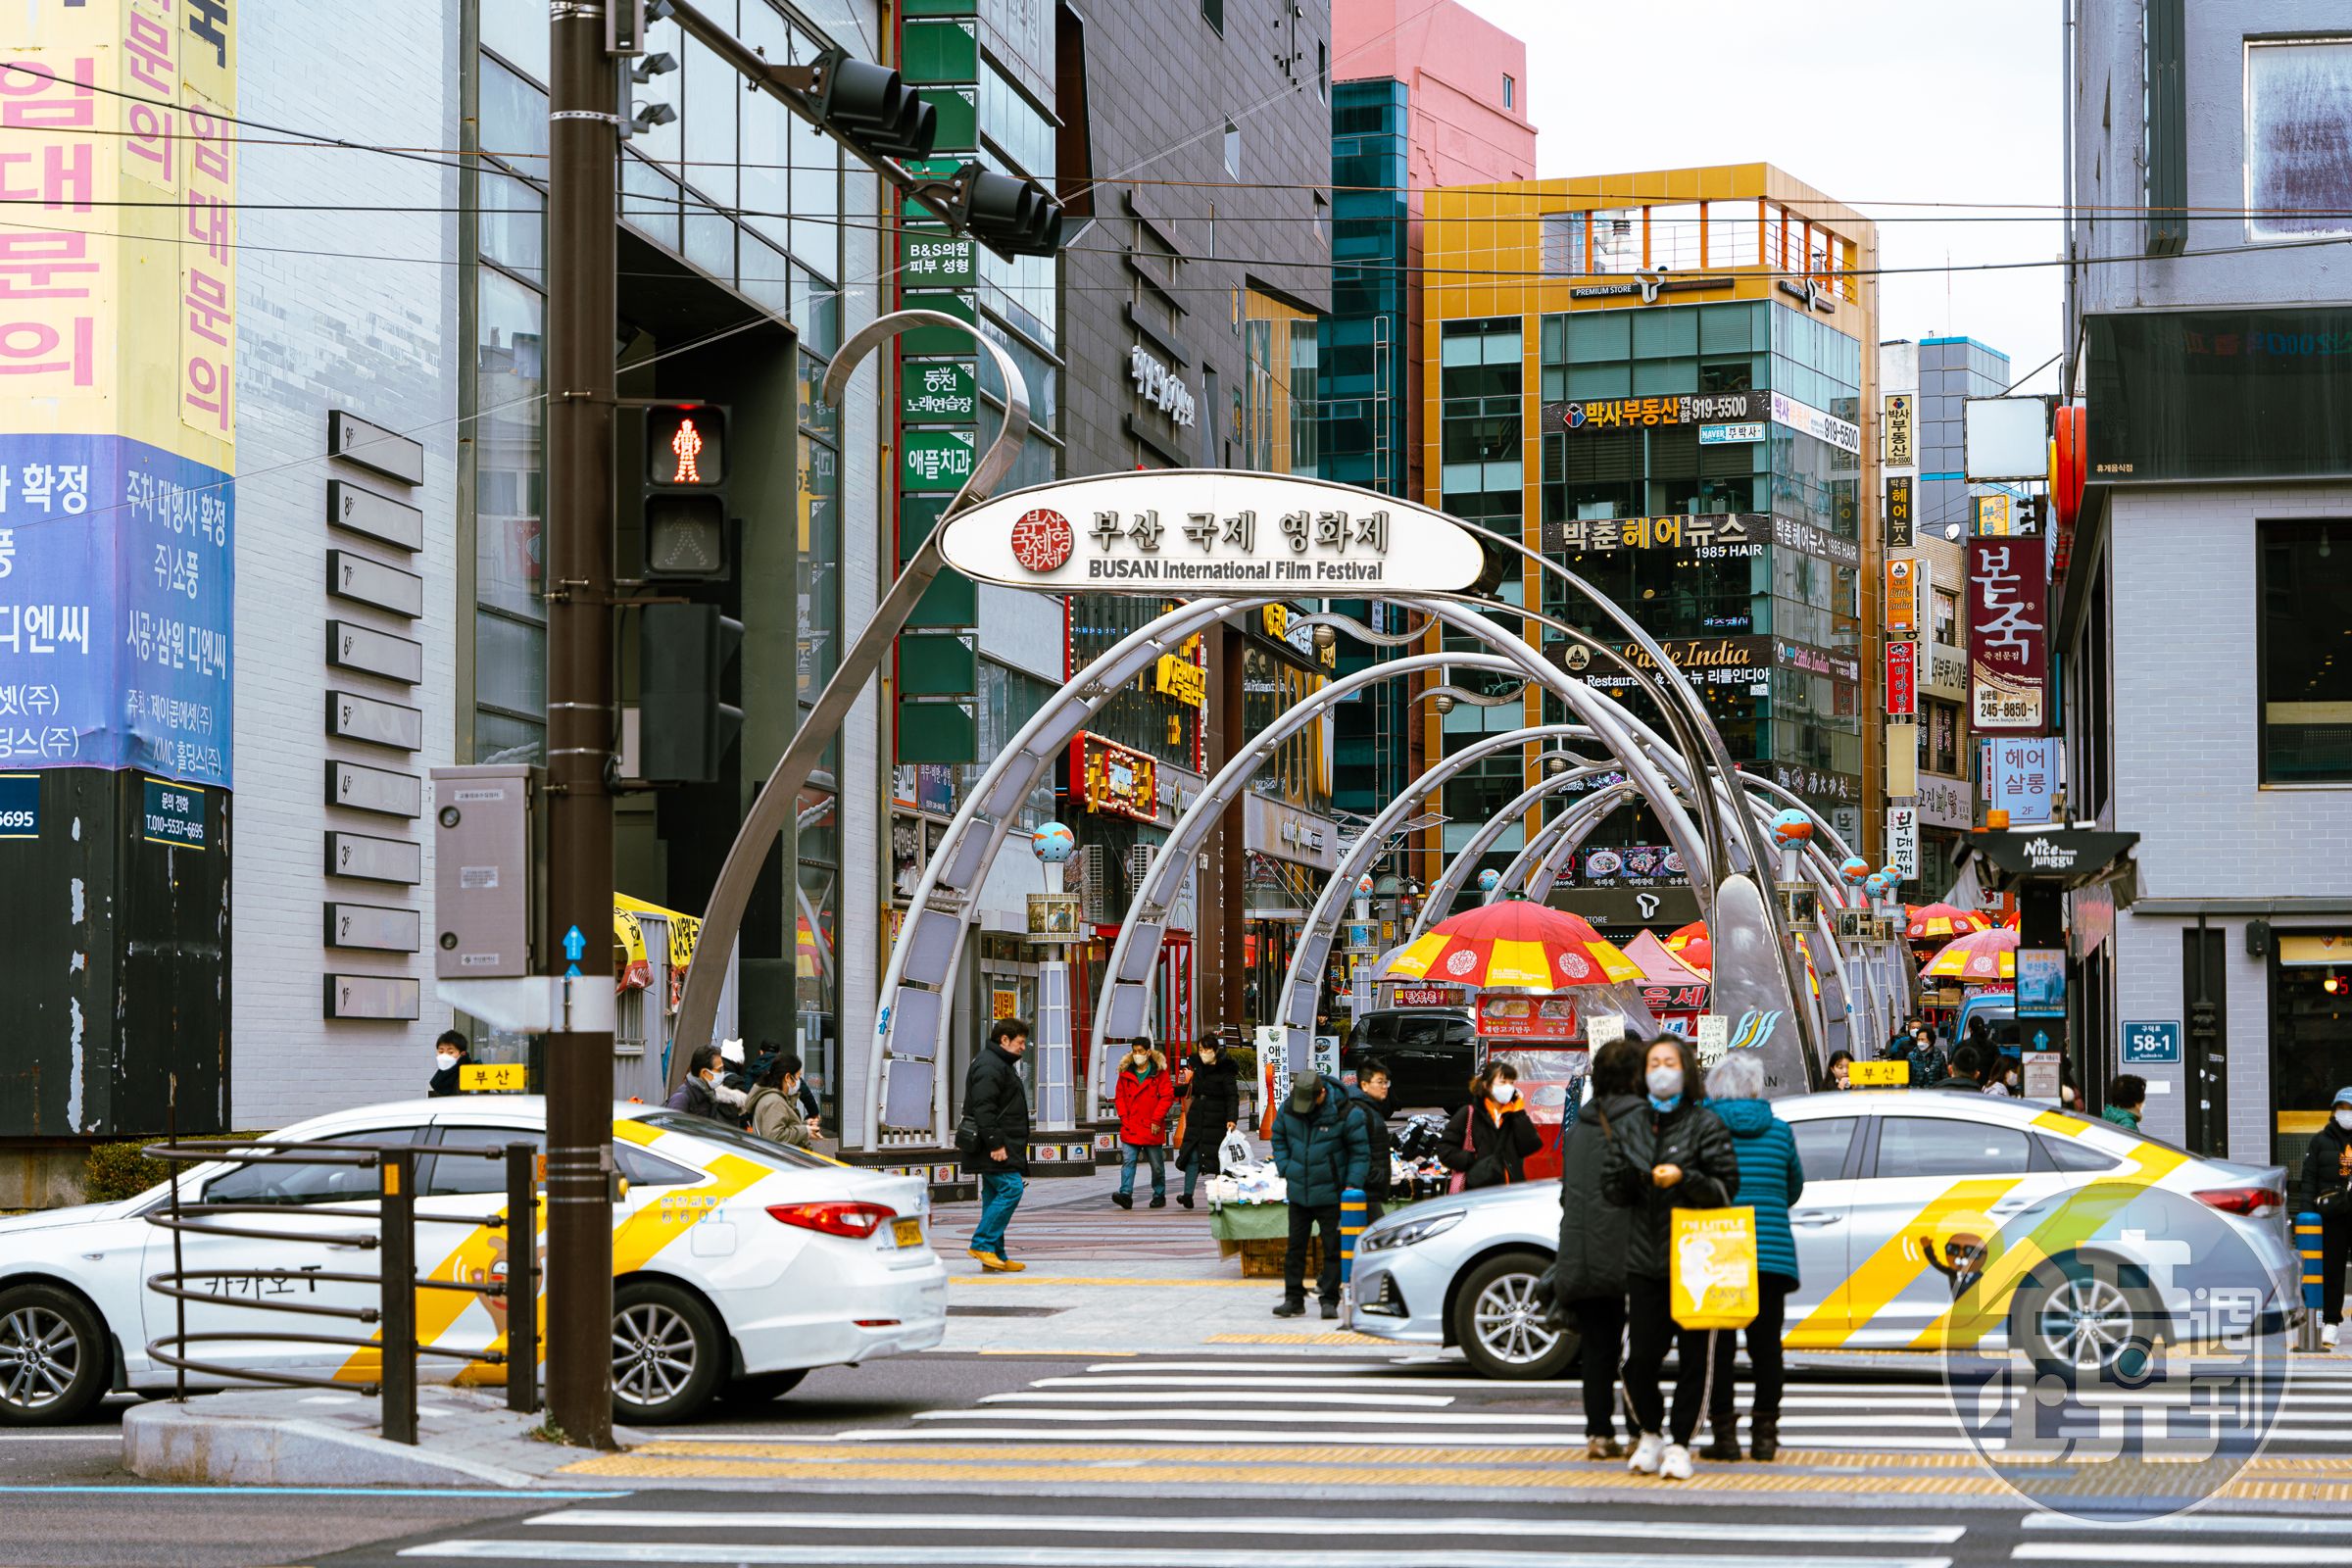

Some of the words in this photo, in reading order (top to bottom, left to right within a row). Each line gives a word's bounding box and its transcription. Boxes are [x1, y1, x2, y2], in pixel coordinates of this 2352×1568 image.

[124, 0, 173, 181] 문의
[909, 242, 969, 257] B&S의원
[185, 104, 231, 431] 임대문의
[909, 260, 937, 273] 피부
[942, 259, 969, 272] 성형
[963, 297, 973, 306] 7F
[1576, 286, 1608, 296] PREMIUM
[963, 366, 973, 374] 6F
[906, 395, 972, 413] 노래연습장
[1586, 397, 1680, 427] 박사부동산
[1692, 397, 1746, 418] 919-5500
[962, 432, 973, 441] 5F
[1702, 429, 1725, 439] NAVER
[1825, 417, 1857, 450] 919-5500
[1891, 420, 1907, 457] 부동산
[908, 449, 971, 479] 애플치과
[2096, 463, 2133, 473] 휴게음식점
[22, 464, 88, 514] 확정
[158, 482, 198, 538] 대행사
[200, 492, 226, 549] 확정
[1088, 510, 1164, 552] 부산
[1182, 510, 1255, 553] 국제
[1279, 510, 1390, 555] 영화제
[1563, 514, 1747, 550] 박춘헤어뉴스
[1695, 546, 1726, 558] 1985
[1730, 545, 1762, 557] HAIR
[1828, 539, 1840, 556] 1985
[1842, 542, 1856, 561] HAIR
[1089, 560, 1158, 580] BUSAN
[1163, 561, 1270, 580] International
[1275, 561, 1311, 580] Film
[1317, 561, 1382, 580] Festival
[1971, 546, 2043, 665] 본죽
[962, 637, 972, 646] 2F
[187, 625, 226, 681] 디엔씨
[1684, 641, 1751, 666] India
[1793, 646, 1811, 669] Little
[1812, 651, 1829, 673] India
[1587, 674, 1642, 686] Restaura
[1655, 673, 1664, 684] &
[1690, 670, 1704, 684] 뉴
[1708, 668, 1769, 683] 리틀인디아
[1895, 664, 1908, 707] 마라탕
[1980, 691, 1998, 701] 남포점
[1981, 703, 2038, 717] 245-8850~1
[2005, 749, 2045, 769] 헤어
[2005, 773, 2046, 795] 살롱
[161, 791, 176, 811] 문의
[176, 794, 189, 814] 전화
[2022, 807, 2034, 815] 2F
[146, 813, 204, 840] T.010-5537-6695
[2023, 837, 2059, 858] Nice
[2032, 853, 2074, 869] junggu
[1643, 986, 1706, 1007] 운세
[2133, 1034, 2170, 1052] 58-1
[473, 1068, 511, 1086] 부산
[1863, 1067, 1895, 1081] 부산
[301, 1265, 321, 1293] T
